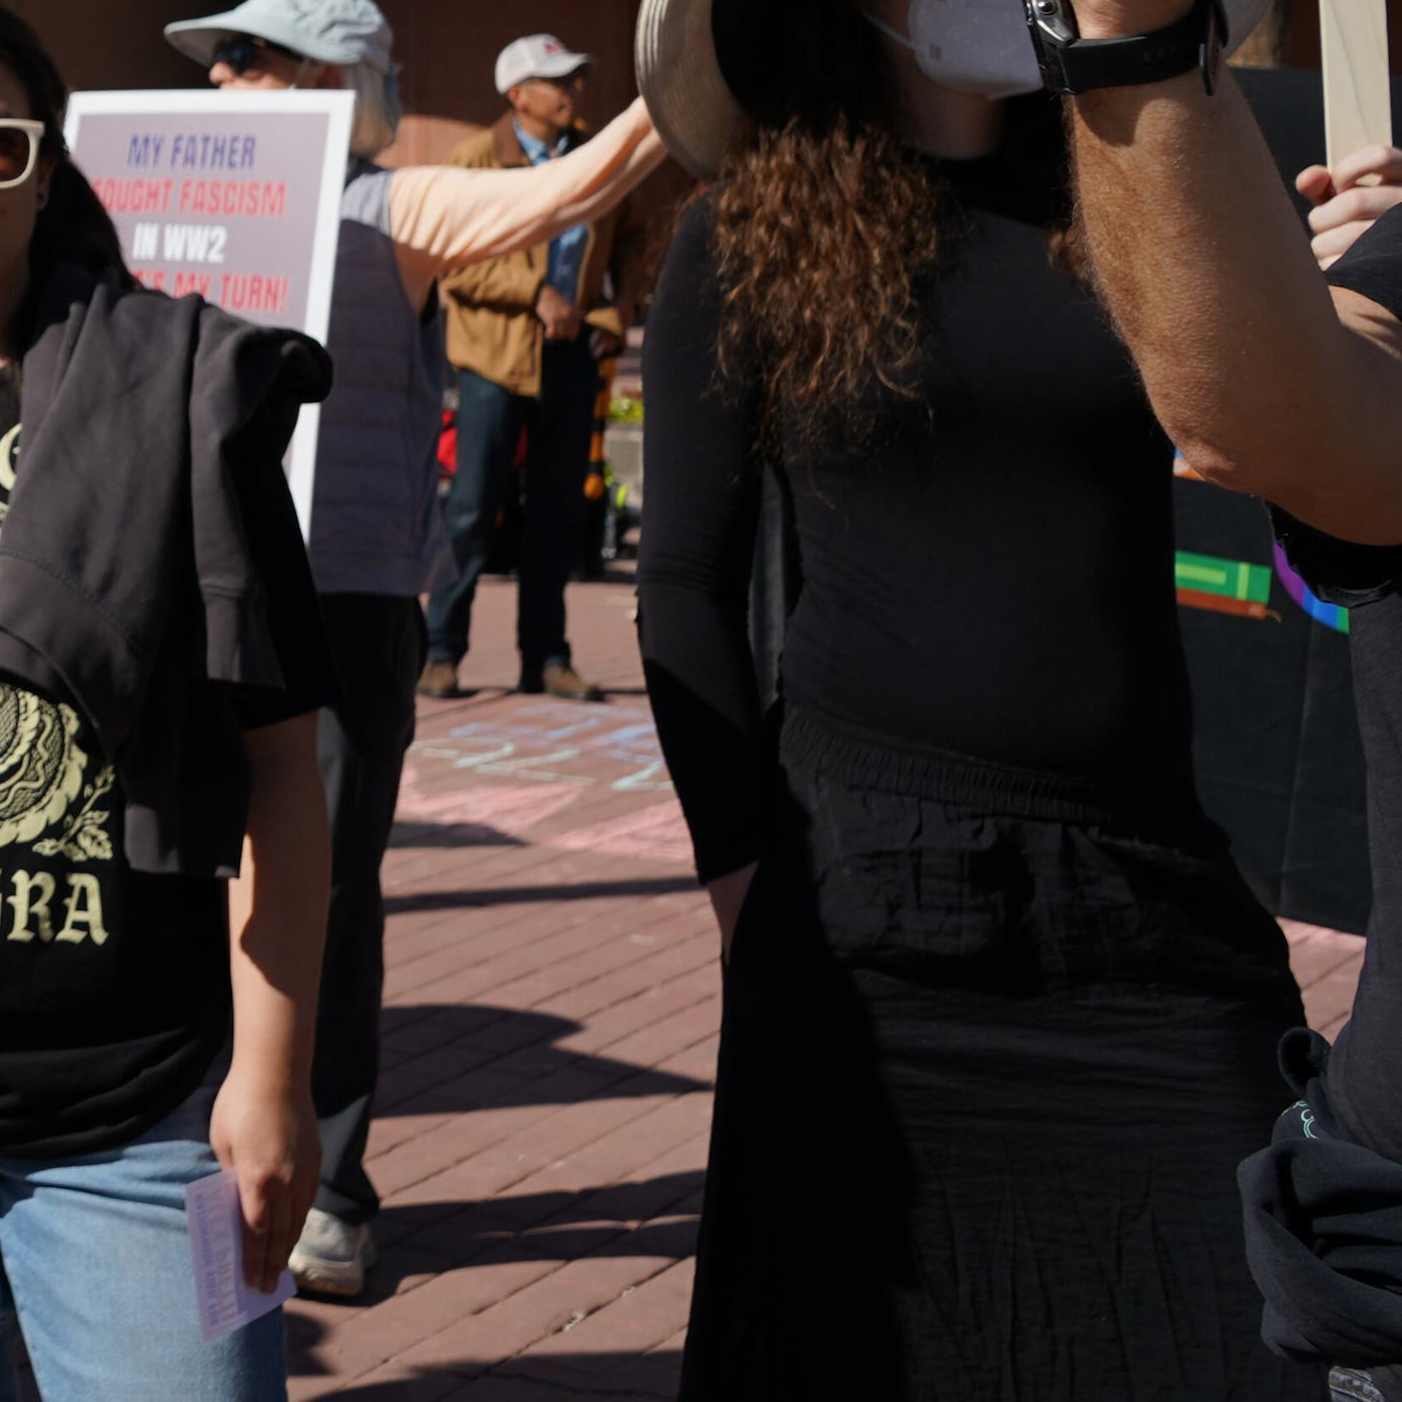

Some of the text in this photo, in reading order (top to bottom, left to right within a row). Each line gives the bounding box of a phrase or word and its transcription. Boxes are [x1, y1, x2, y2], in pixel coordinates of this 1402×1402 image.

[127, 133, 256, 169] MY FATHER
[179, 179, 288, 218] FASCISM
[132, 222, 227, 263] IN WW2
[220, 273, 290, 313] TURN!
